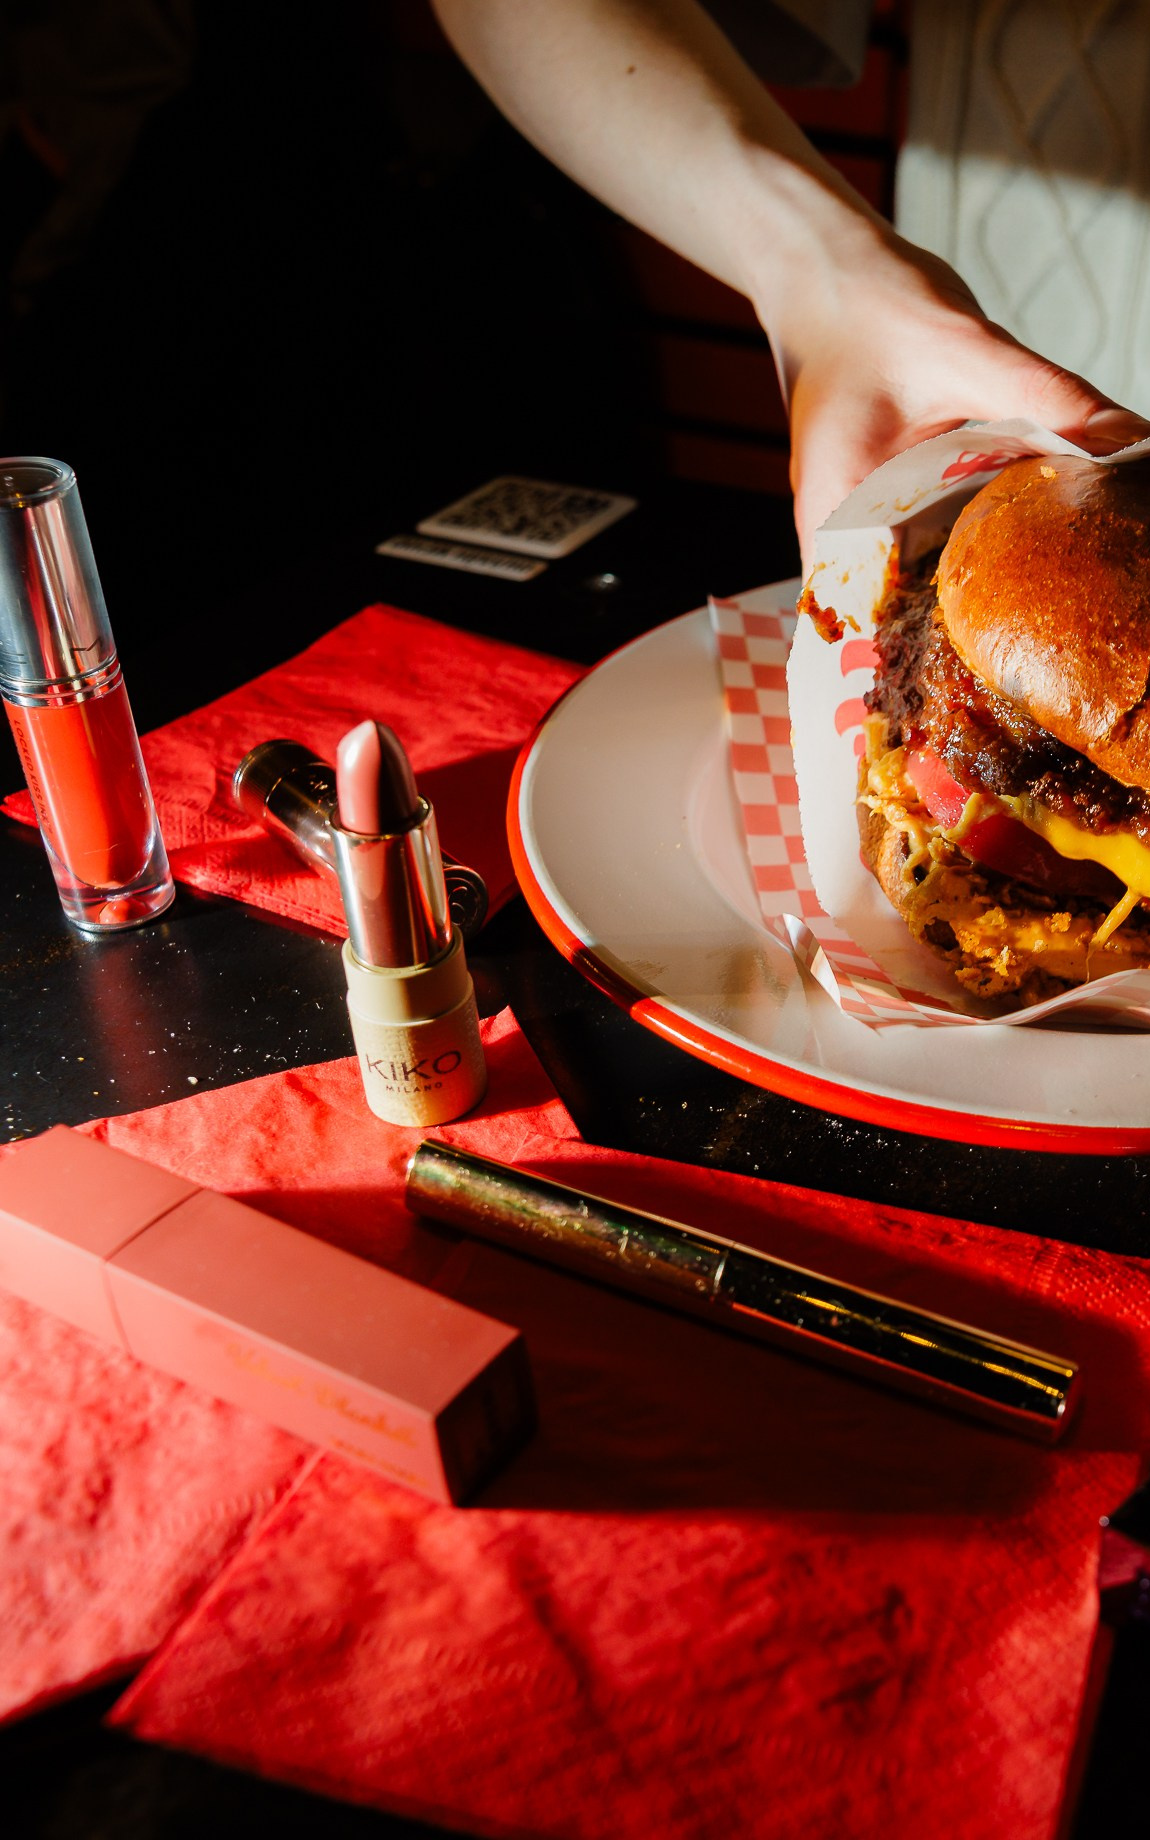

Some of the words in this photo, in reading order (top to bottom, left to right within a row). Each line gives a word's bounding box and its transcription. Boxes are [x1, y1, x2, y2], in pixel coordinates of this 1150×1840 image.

[13, 719, 34, 776] LOCKED
[30, 773, 43, 802] KISS
[365, 1050, 462, 1081] KIKO
[385, 1081, 443, 1093] MILANO
